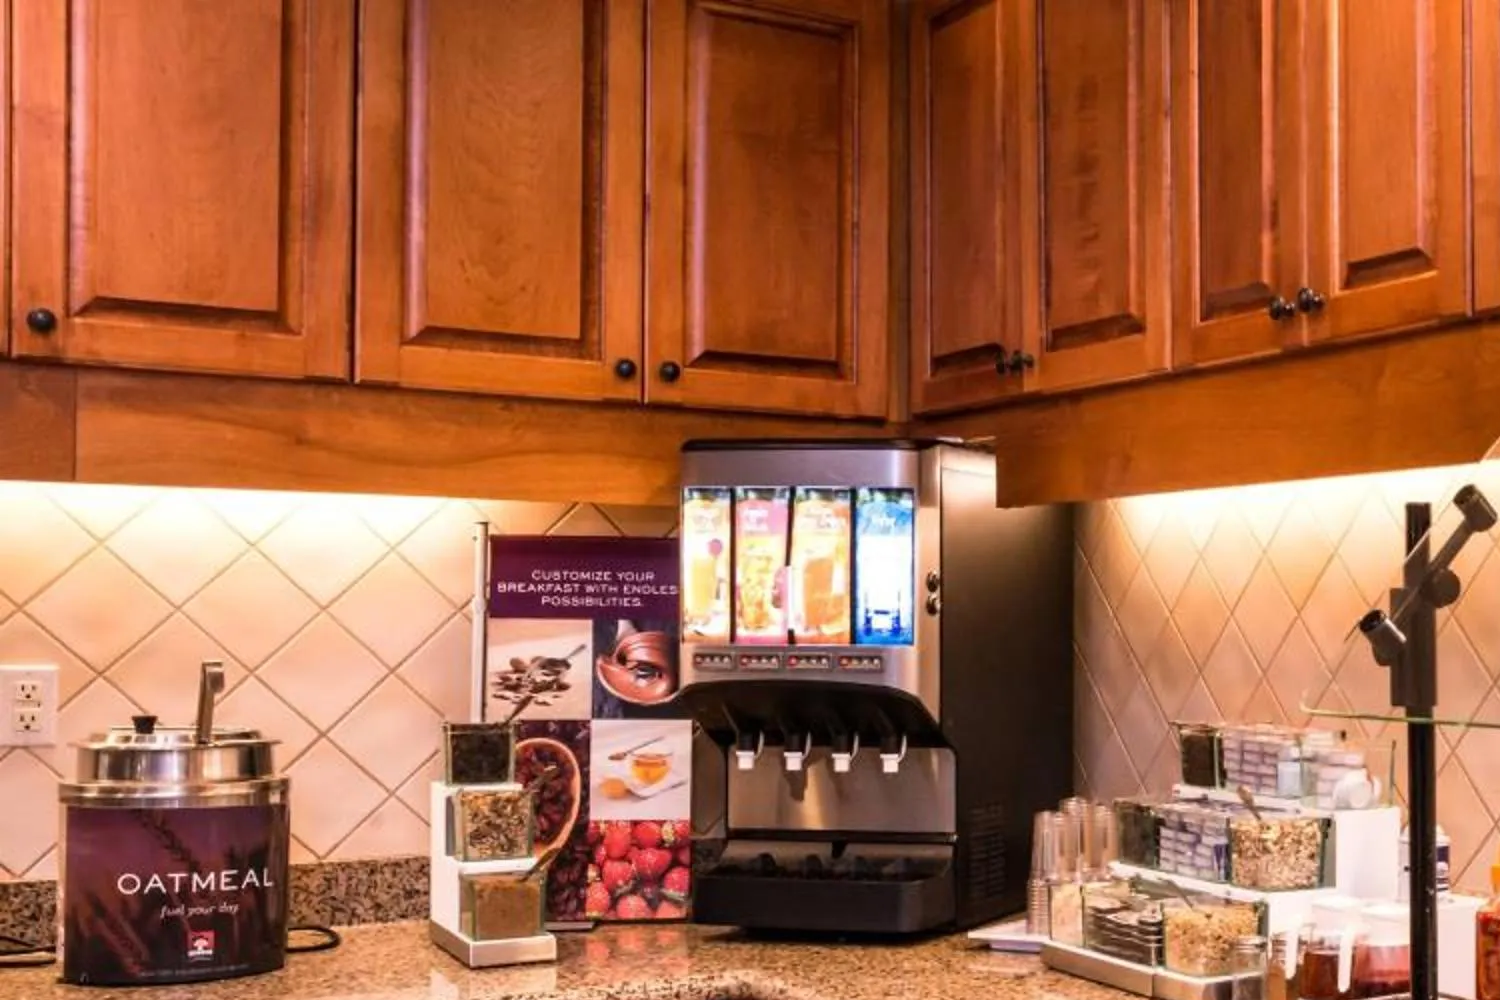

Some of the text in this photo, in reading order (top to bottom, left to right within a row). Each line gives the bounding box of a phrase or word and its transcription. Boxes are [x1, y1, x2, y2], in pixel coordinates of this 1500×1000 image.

[531, 569, 655, 582] CUSTOMIZE YOUR
[497, 582, 679, 595] BREAKFAST WITH ENDLES
[117, 867, 274, 895] OATMEAL
[160, 901, 240, 919] fuel your day
